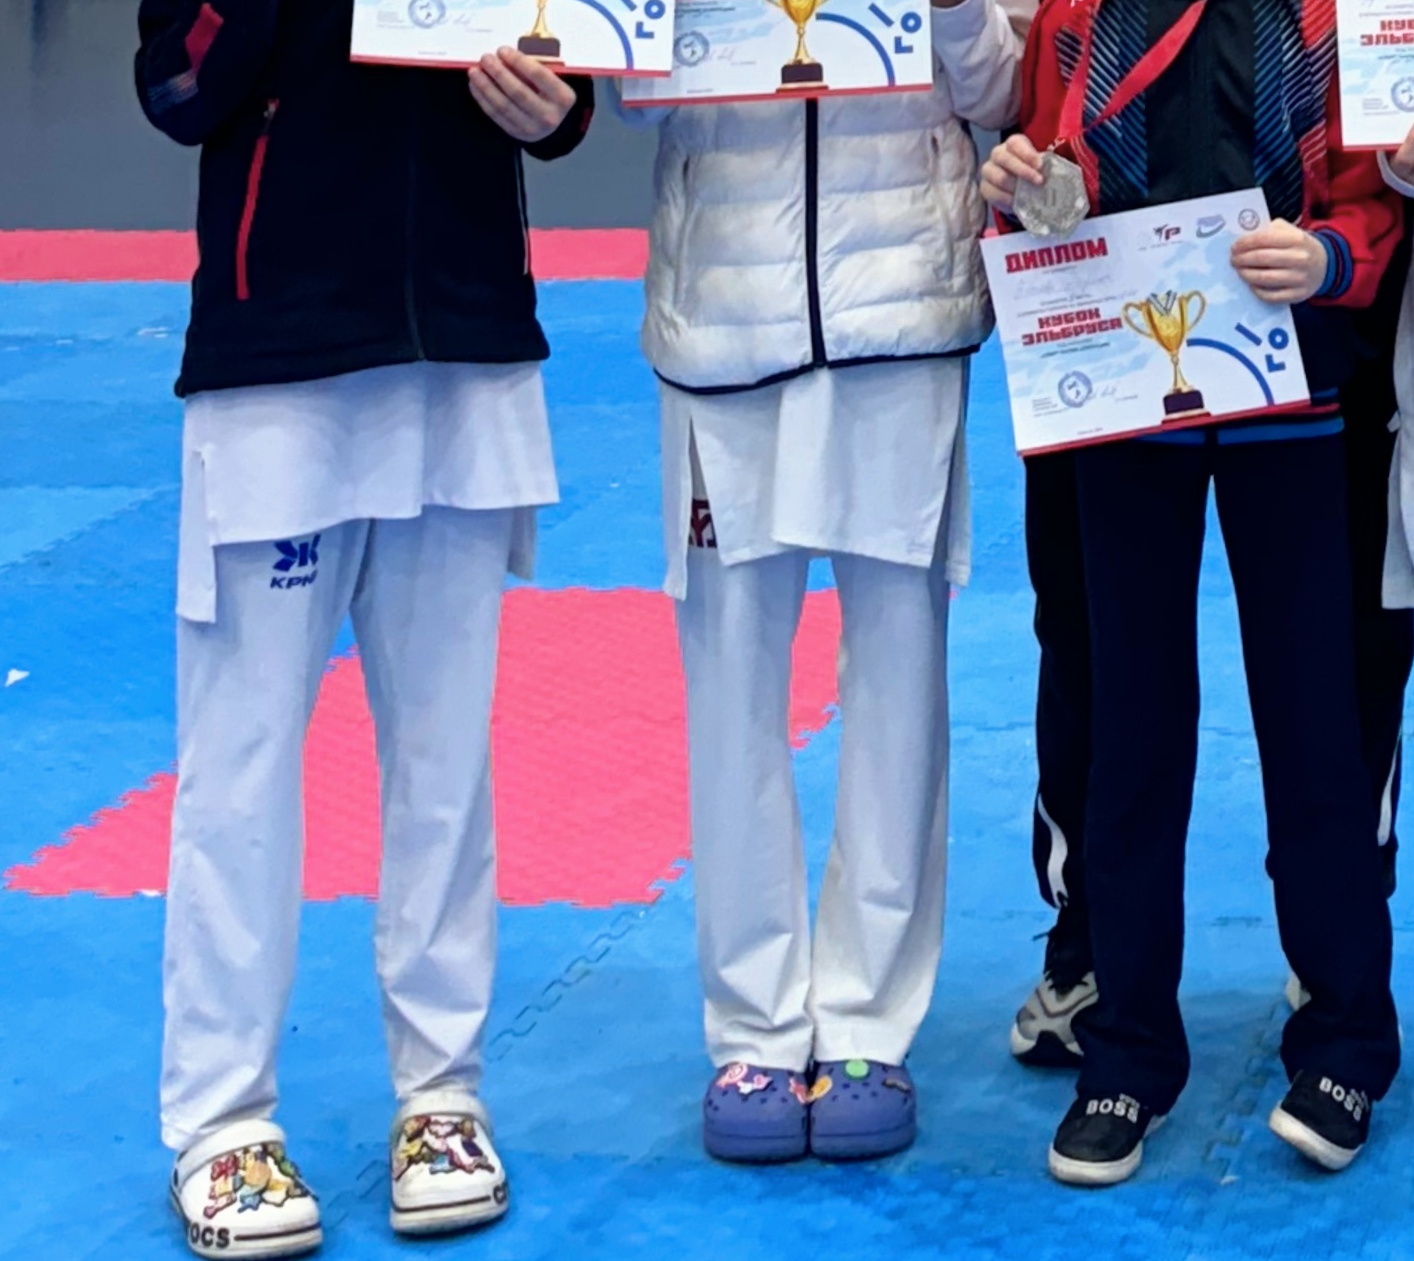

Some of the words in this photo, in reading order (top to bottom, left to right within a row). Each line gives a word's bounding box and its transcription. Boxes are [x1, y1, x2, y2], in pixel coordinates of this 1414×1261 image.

[1005, 237, 1108, 274] ДИПЛОМ
[1022, 317, 1123, 347] ЭЛЬБРУСА
[1038, 307, 1101, 330] КУБОК
[1085, 1098, 1139, 1124] BOSS
[1319, 1076, 1363, 1123] BOSS
